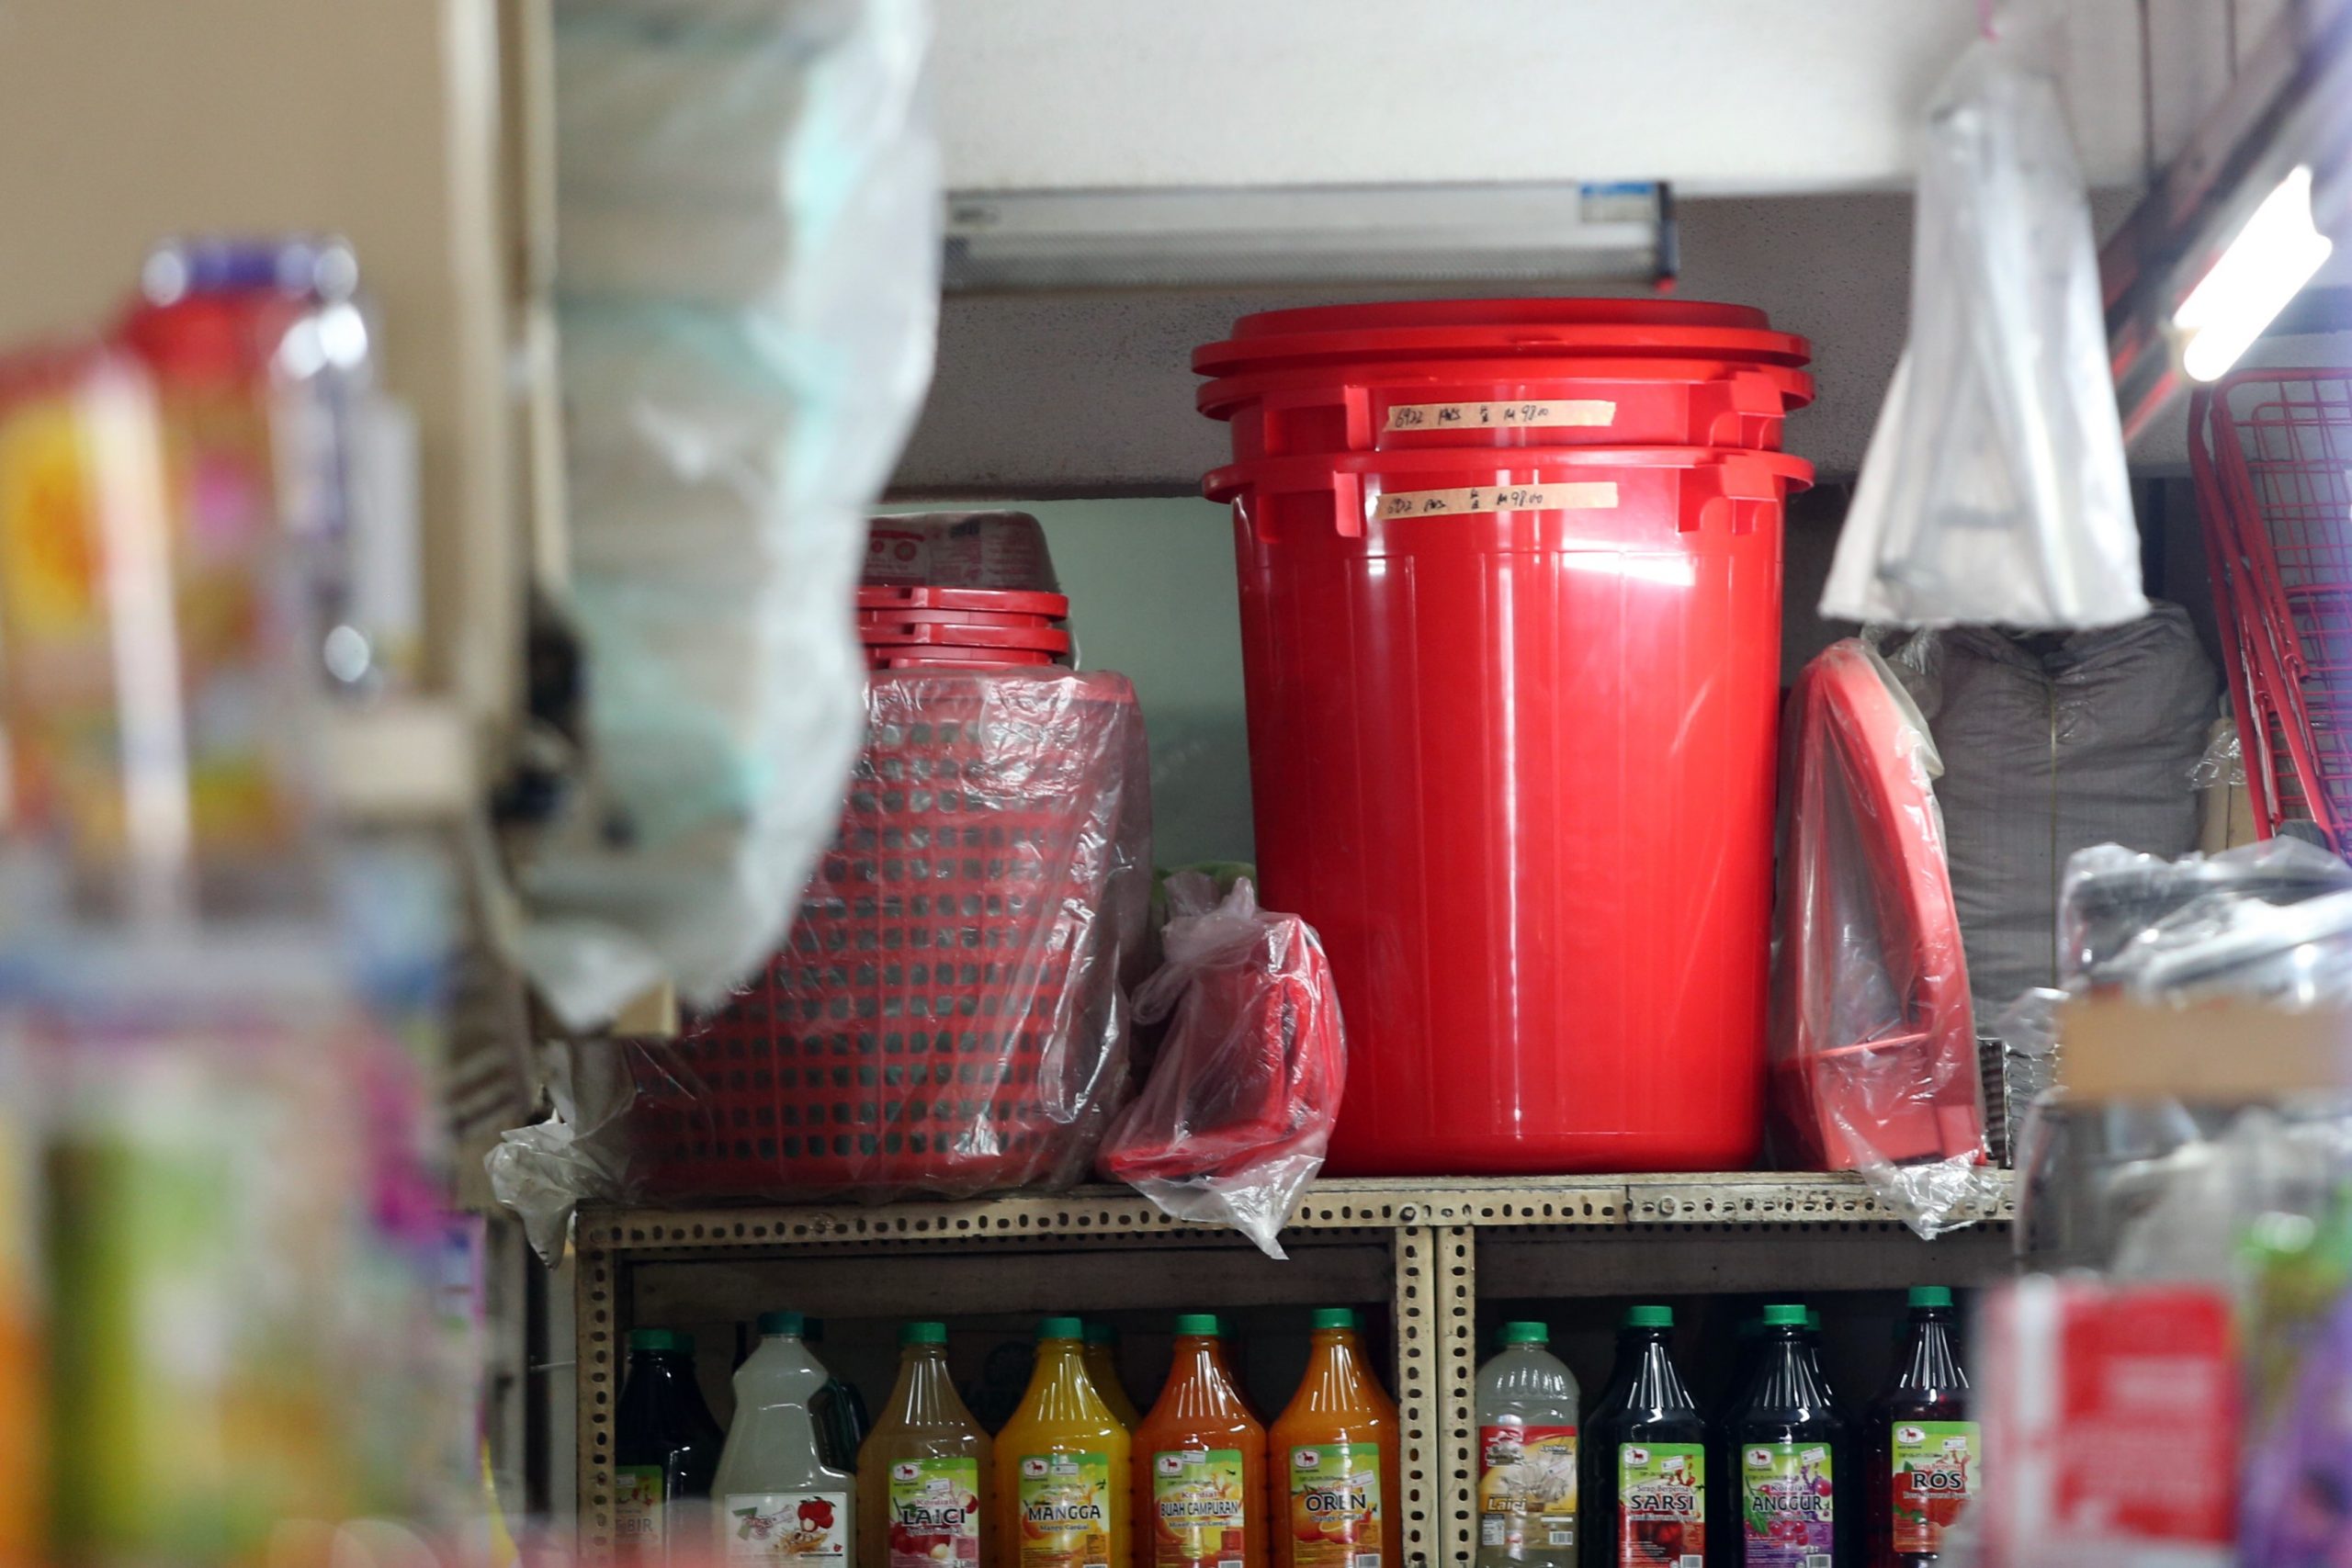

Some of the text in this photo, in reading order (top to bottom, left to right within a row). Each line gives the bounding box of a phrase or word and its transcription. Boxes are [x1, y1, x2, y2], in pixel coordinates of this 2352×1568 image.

[1160, 1501, 1238, 1517] BUAH CAMPURAN
[1631, 1495, 1693, 1510] SARSI
[1752, 1495, 1824, 1511] ANGGUR
[903, 1508, 966, 1525] LAICI
[1028, 1505, 1101, 1521] MANGGA
